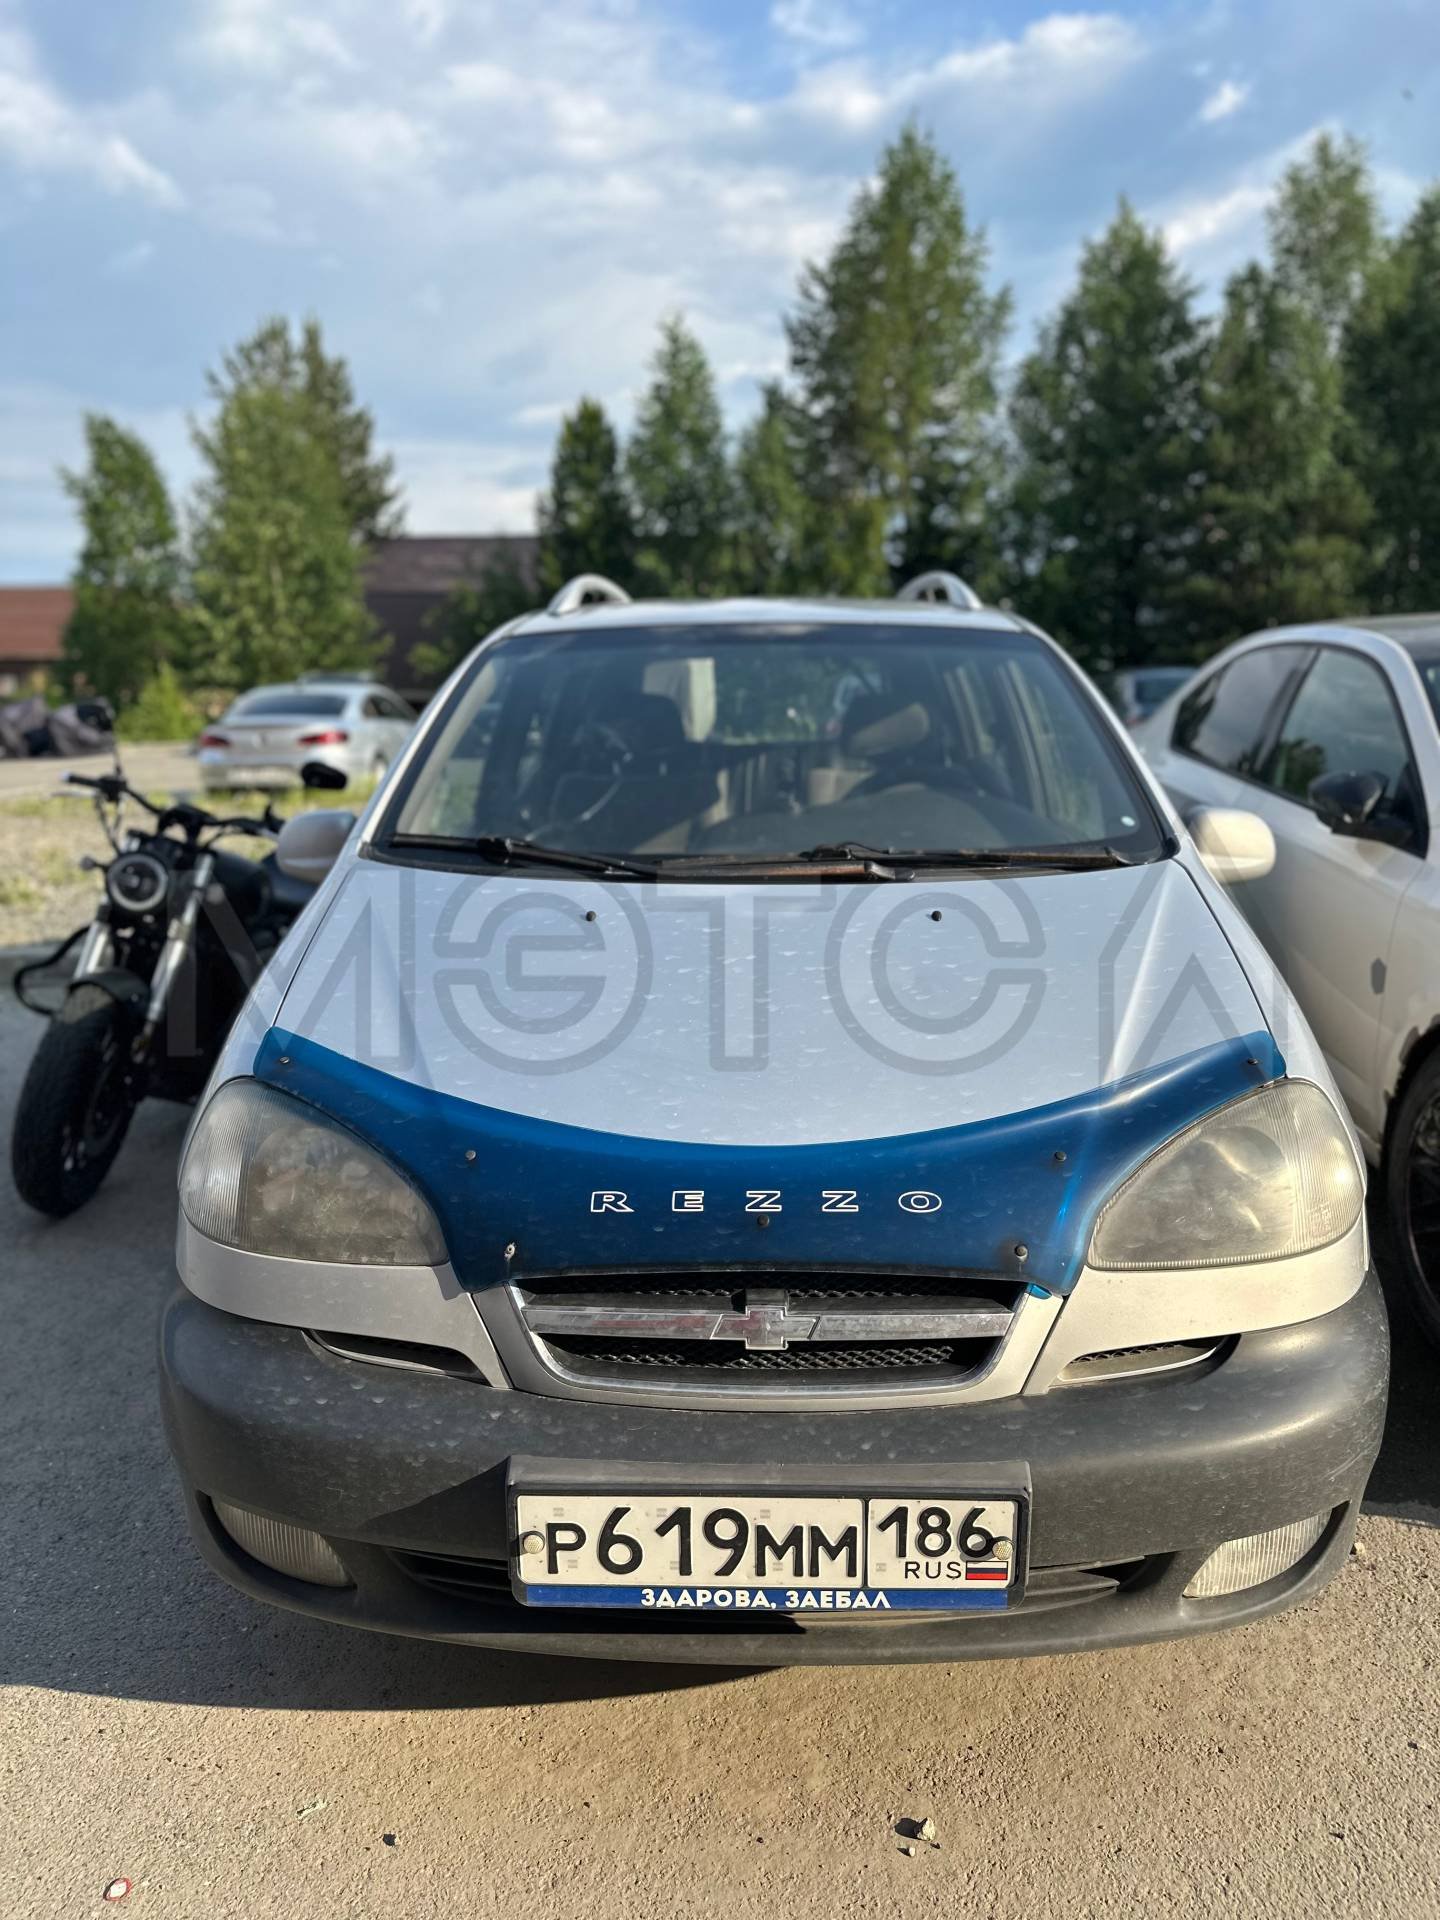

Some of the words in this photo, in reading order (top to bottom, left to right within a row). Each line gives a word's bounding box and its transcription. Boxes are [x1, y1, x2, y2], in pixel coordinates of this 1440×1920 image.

[590, 1191, 942, 1213] REZZO
[546, 1506, 858, 1578] Р619ММ
[878, 1506, 994, 1558] 186
[904, 1560, 962, 1579] RUS
[641, 1588, 776, 1609] ЗДАРОВА,
[785, 1590, 891, 1609] ЗАЕБАЛ
